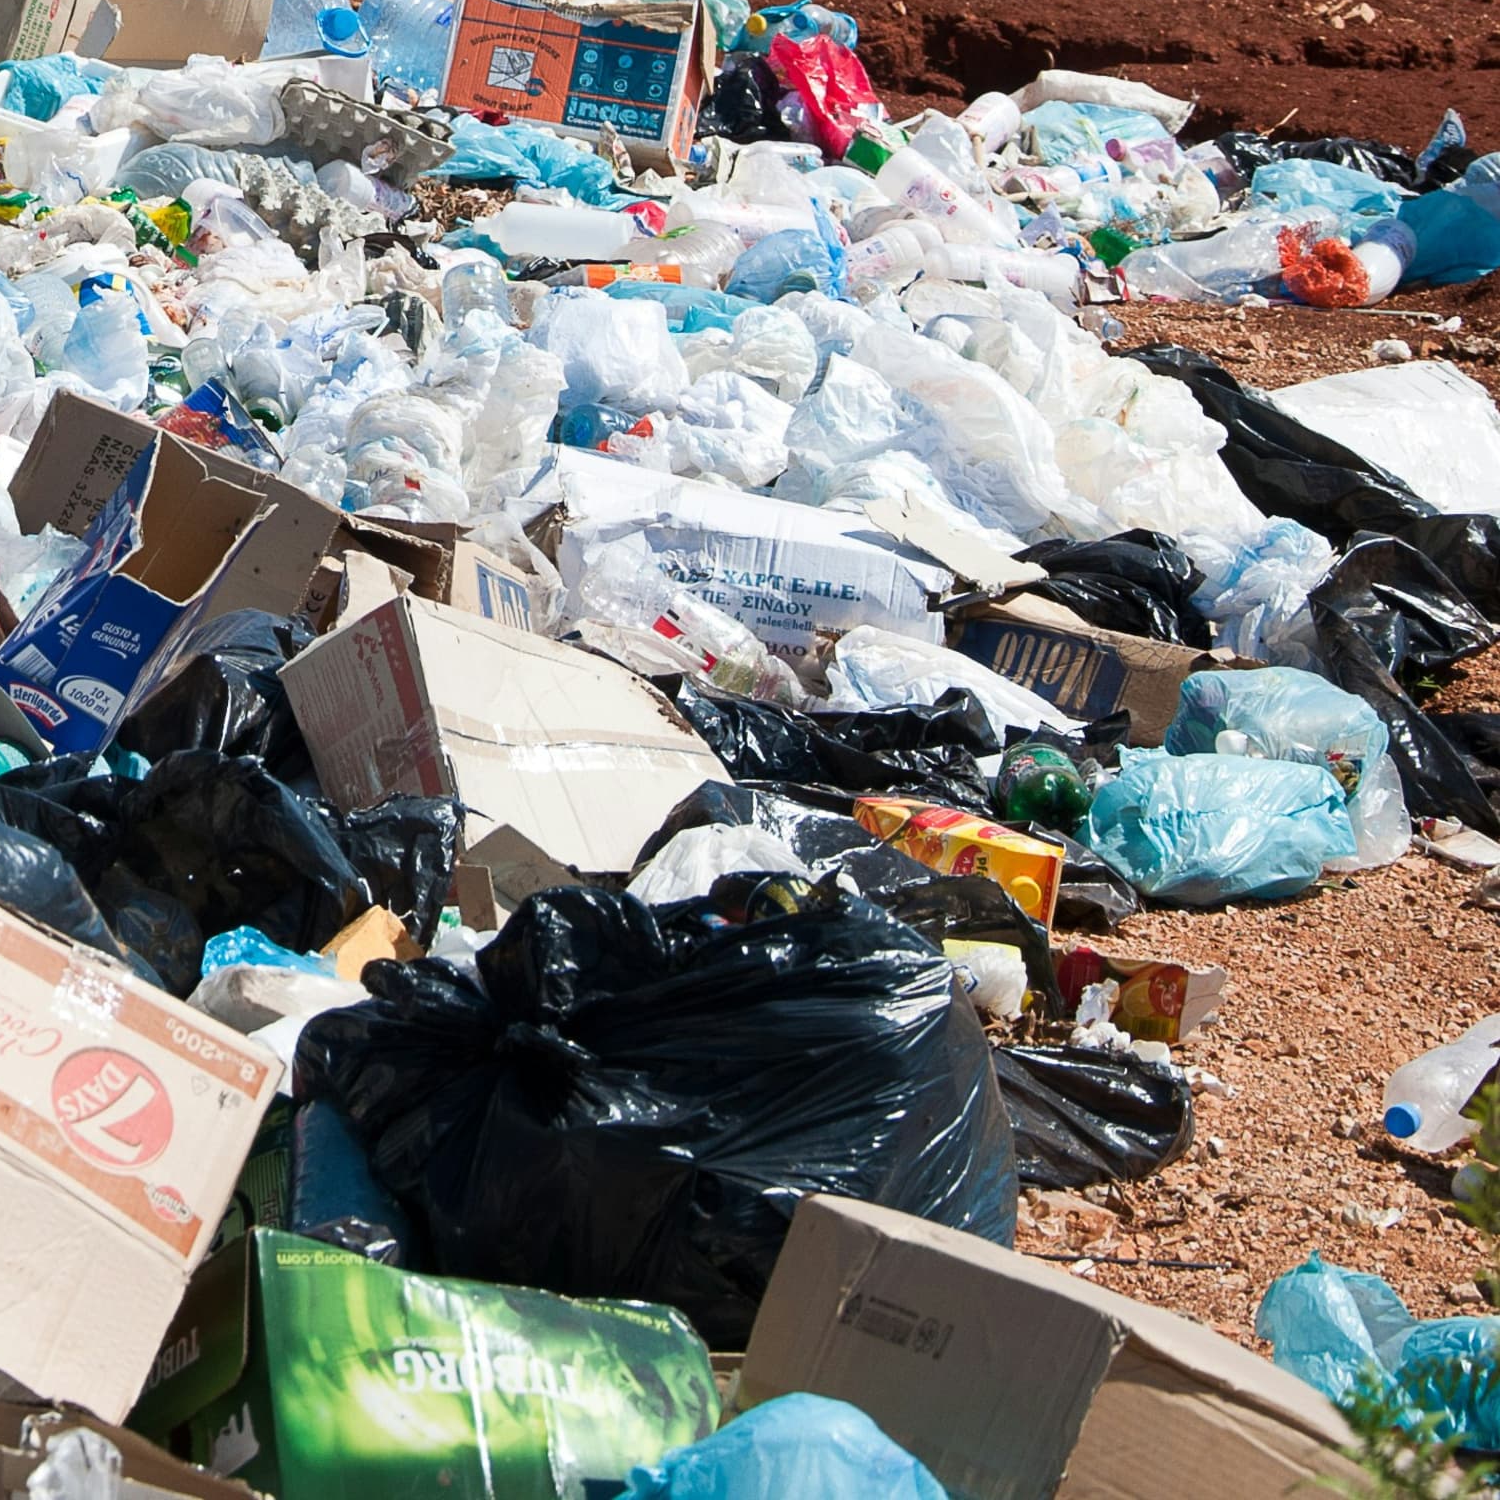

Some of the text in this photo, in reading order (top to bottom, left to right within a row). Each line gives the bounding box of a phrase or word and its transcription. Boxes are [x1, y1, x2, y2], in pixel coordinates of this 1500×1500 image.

[569, 97, 660, 128] index
[91, 630, 141, 655] GENUINITÀ
[101, 621, 133, 640] GUSTO
[991, 630, 1105, 710] Molto
[13, 687, 62, 722] sterilgarda
[69, 687, 109, 716] 1000 ml
[90, 686, 104, 700] 10
[56, 1060, 129, 1124] DAYS
[74, 1077, 157, 1165] 7
